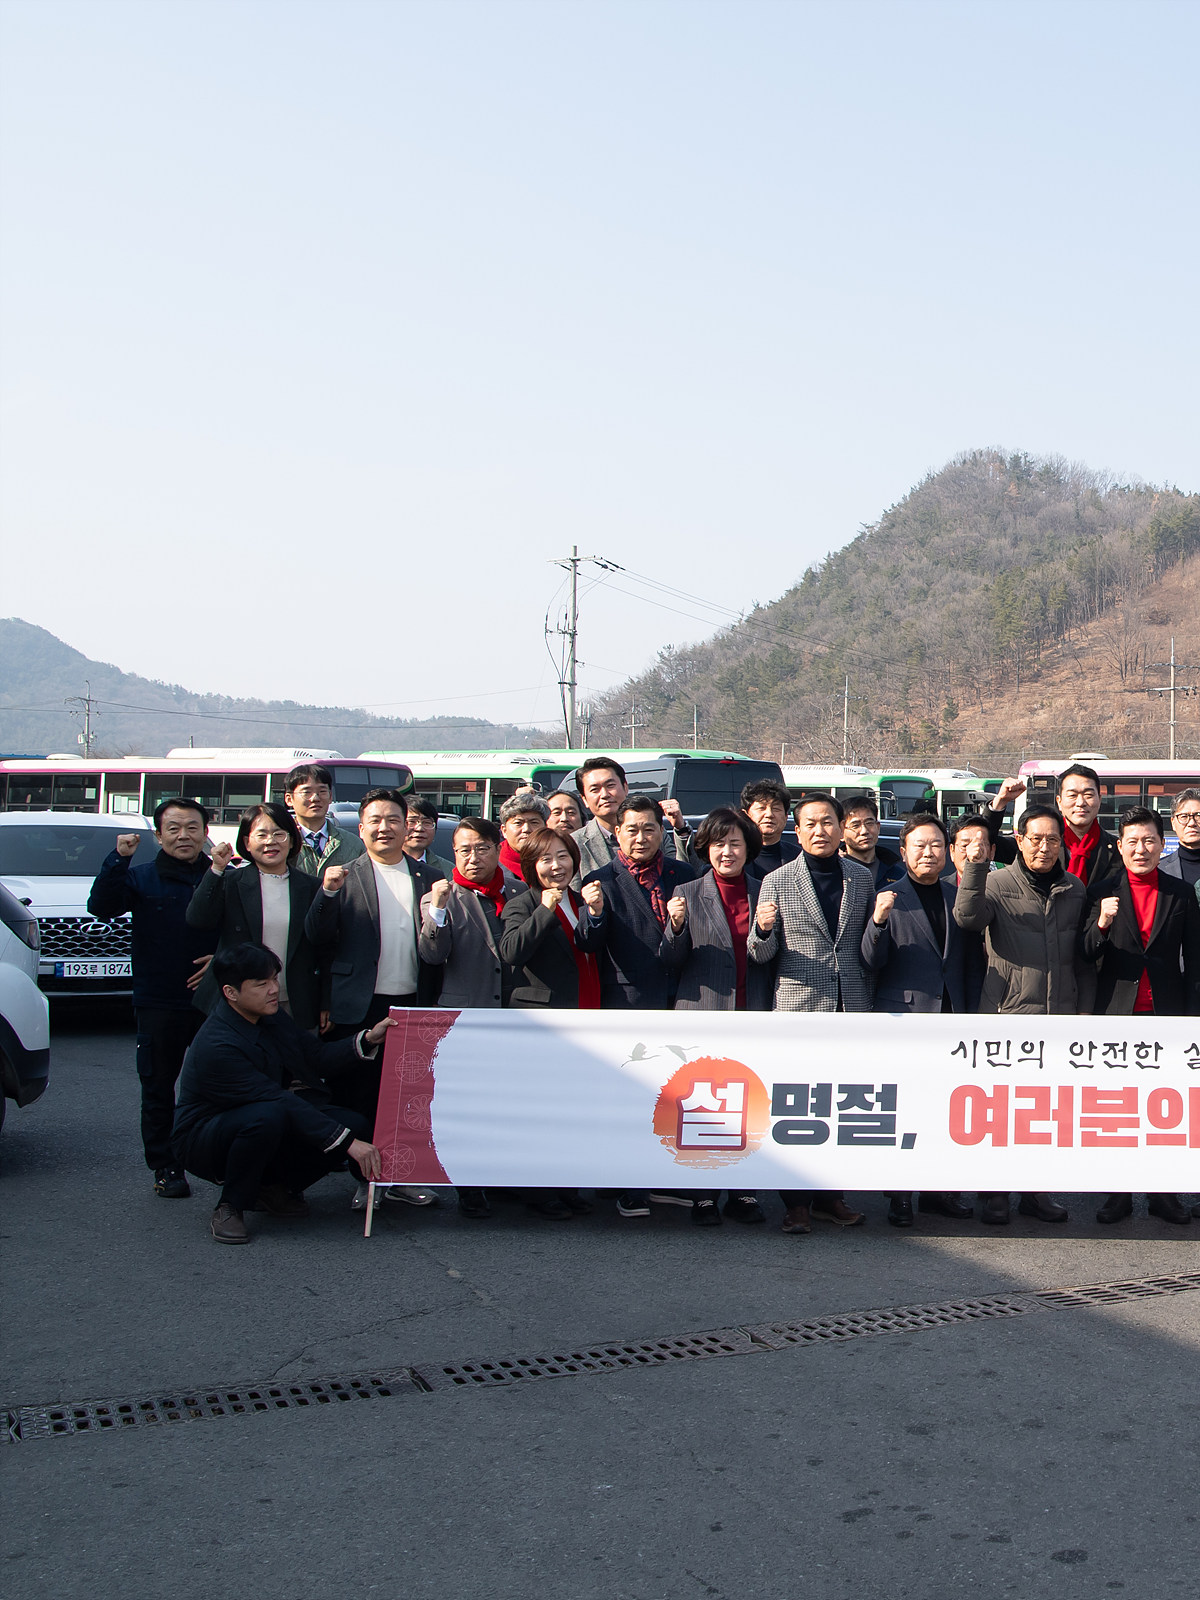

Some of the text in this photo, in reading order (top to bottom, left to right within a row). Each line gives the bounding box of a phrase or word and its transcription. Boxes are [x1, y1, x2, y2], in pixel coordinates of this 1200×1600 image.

[66, 963, 131, 975] 193루 1874
[950, 1040, 1045, 1070] 시민의
[1068, 1040, 1164, 1070] 안전한
[676, 1078, 748, 1150] 설
[770, 1082, 918, 1150] 명절,
